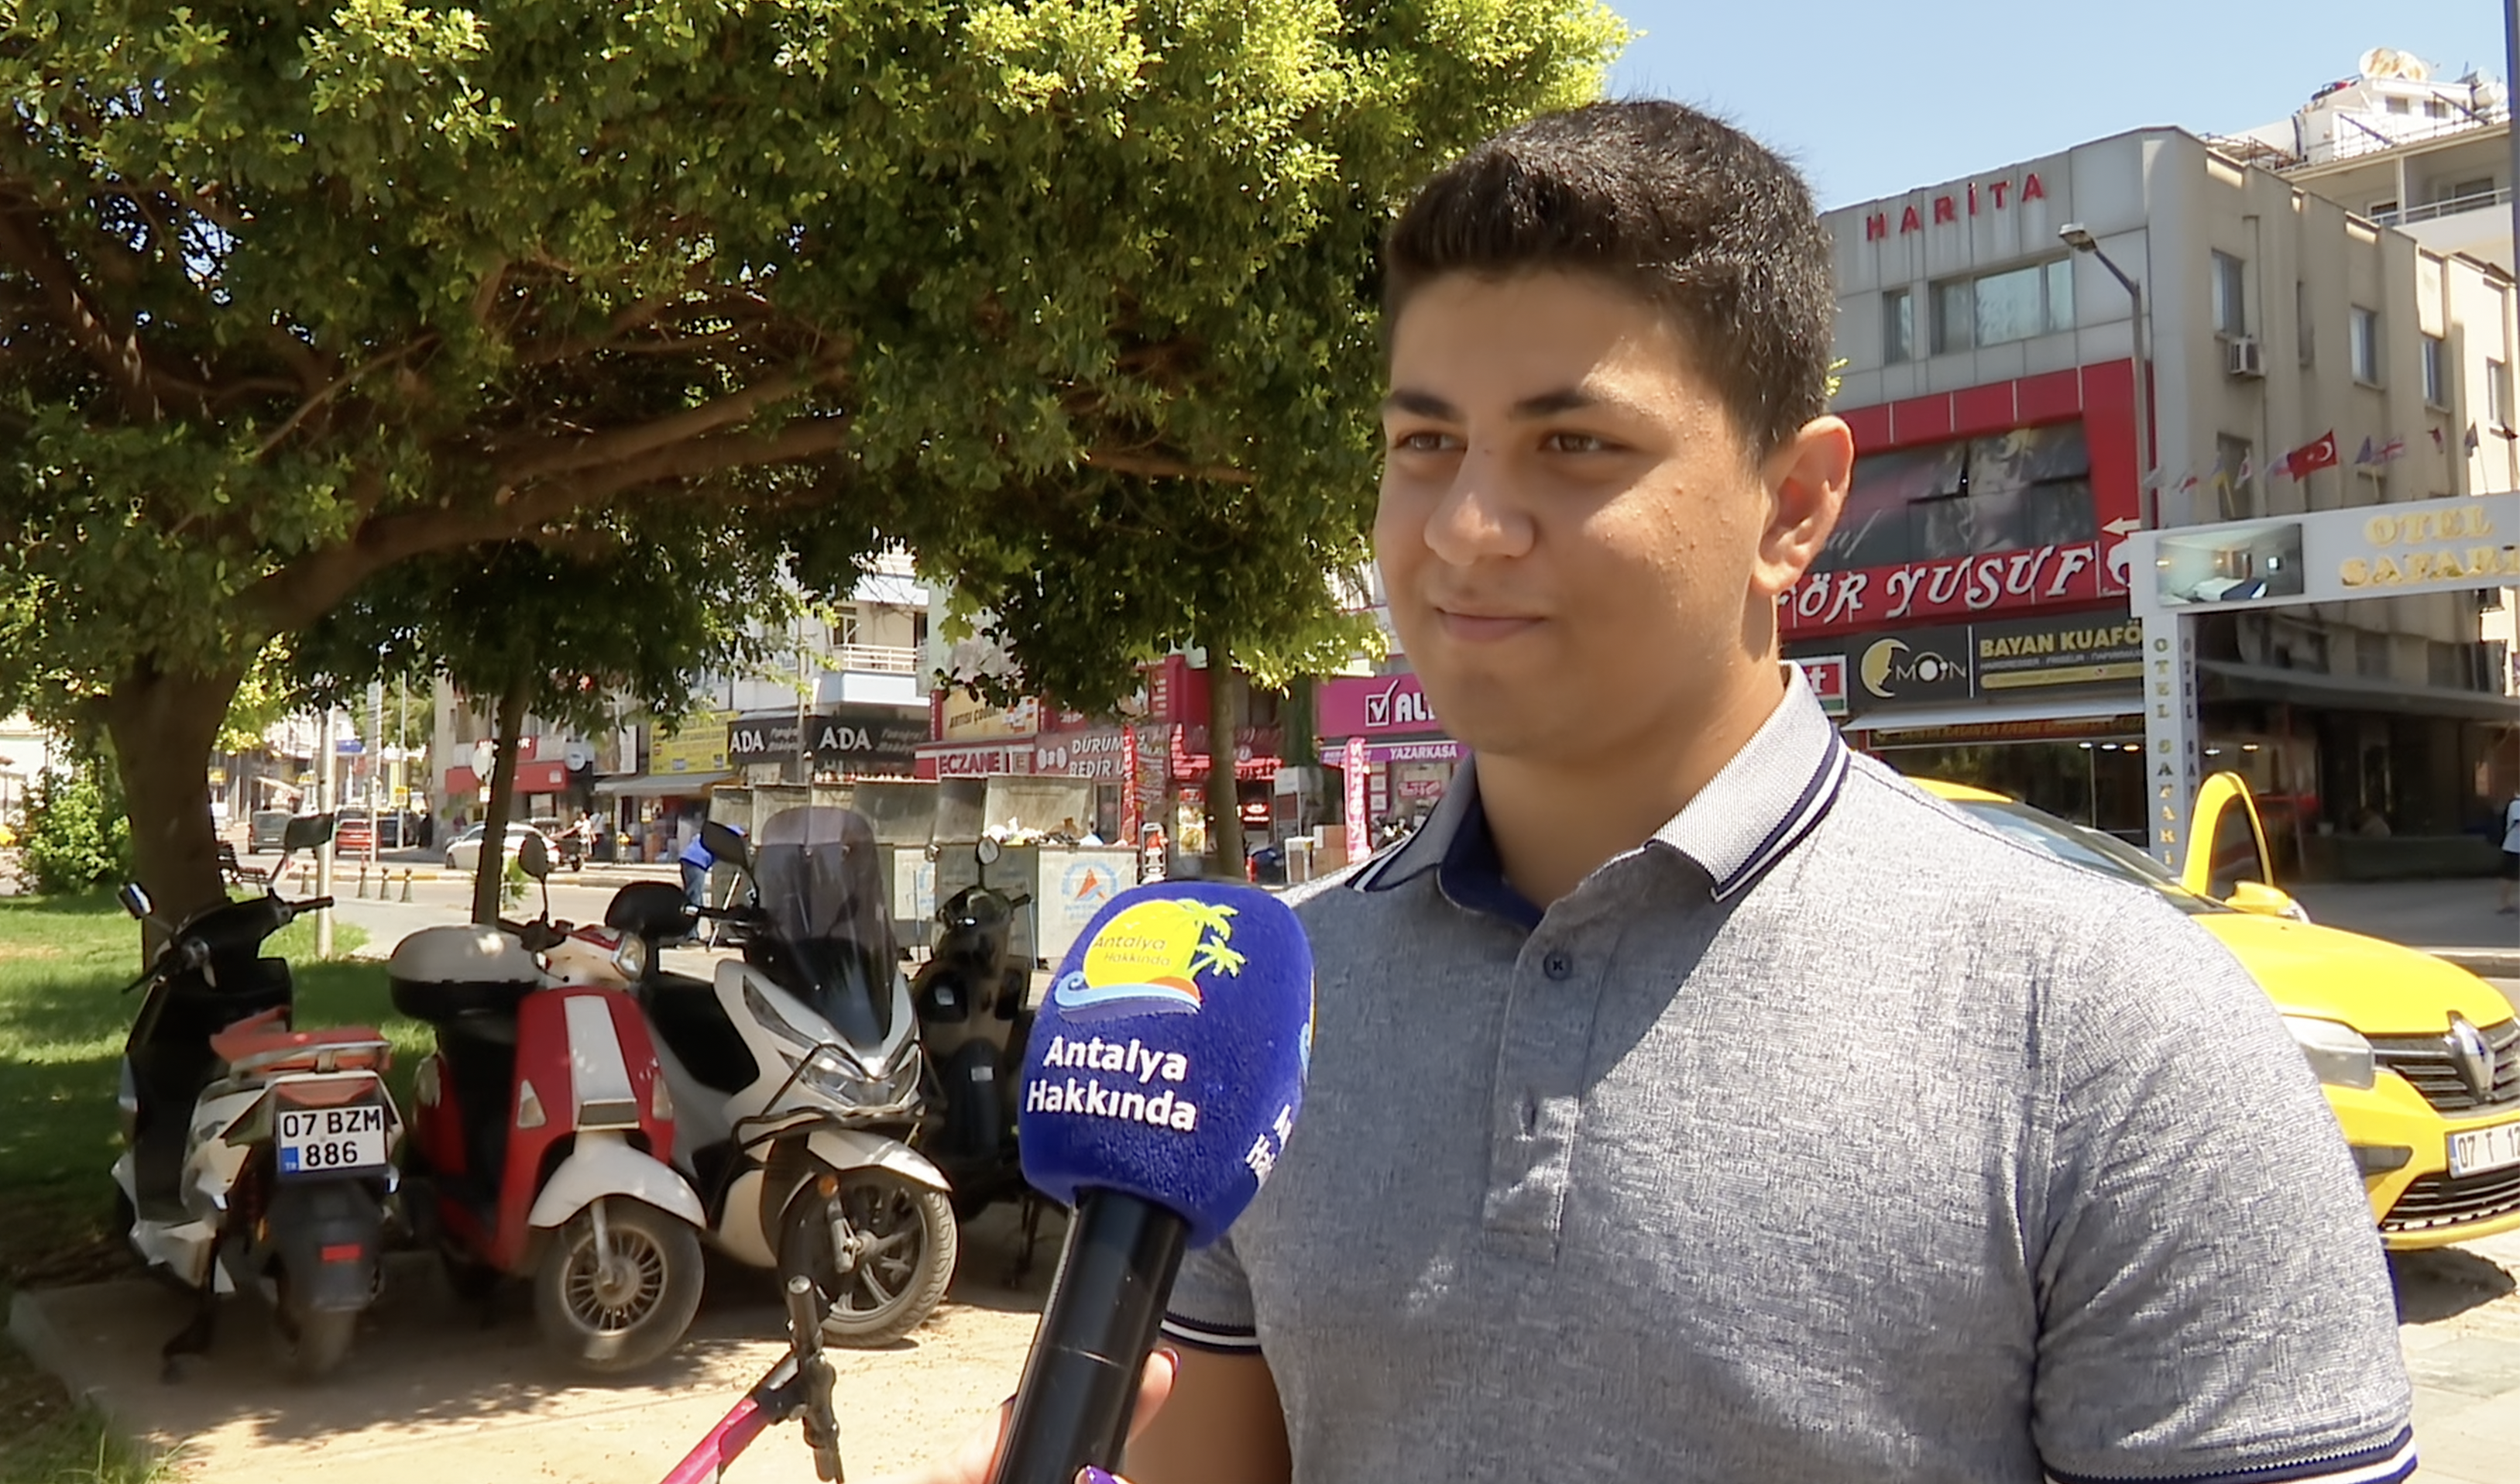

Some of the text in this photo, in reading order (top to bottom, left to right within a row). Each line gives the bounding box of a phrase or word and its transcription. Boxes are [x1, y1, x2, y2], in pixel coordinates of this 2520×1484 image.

[1866, 173, 2044, 242] HARİTA
[2366, 506, 2493, 547] OTEL
[1886, 545, 2094, 618] YUSUF
[1979, 634, 2054, 658] BAYAN
[2154, 637, 2170, 720] OTEL
[2183, 637, 2193, 720] OTEL
[729, 730, 766, 753] ADA
[818, 726, 873, 751] ADA
[1389, 744, 1457, 761] YAZARKASA
[939, 751, 1001, 774] ECZANE
[1093, 935, 1165, 952] Antalya
[1042, 1036, 1187, 1083] Antalya
[1026, 1077, 1196, 1132] Hakkında
[283, 1109, 380, 1137] 07 BZM
[306, 1141, 357, 1166] 886
[2458, 1135, 2475, 1168] 07
